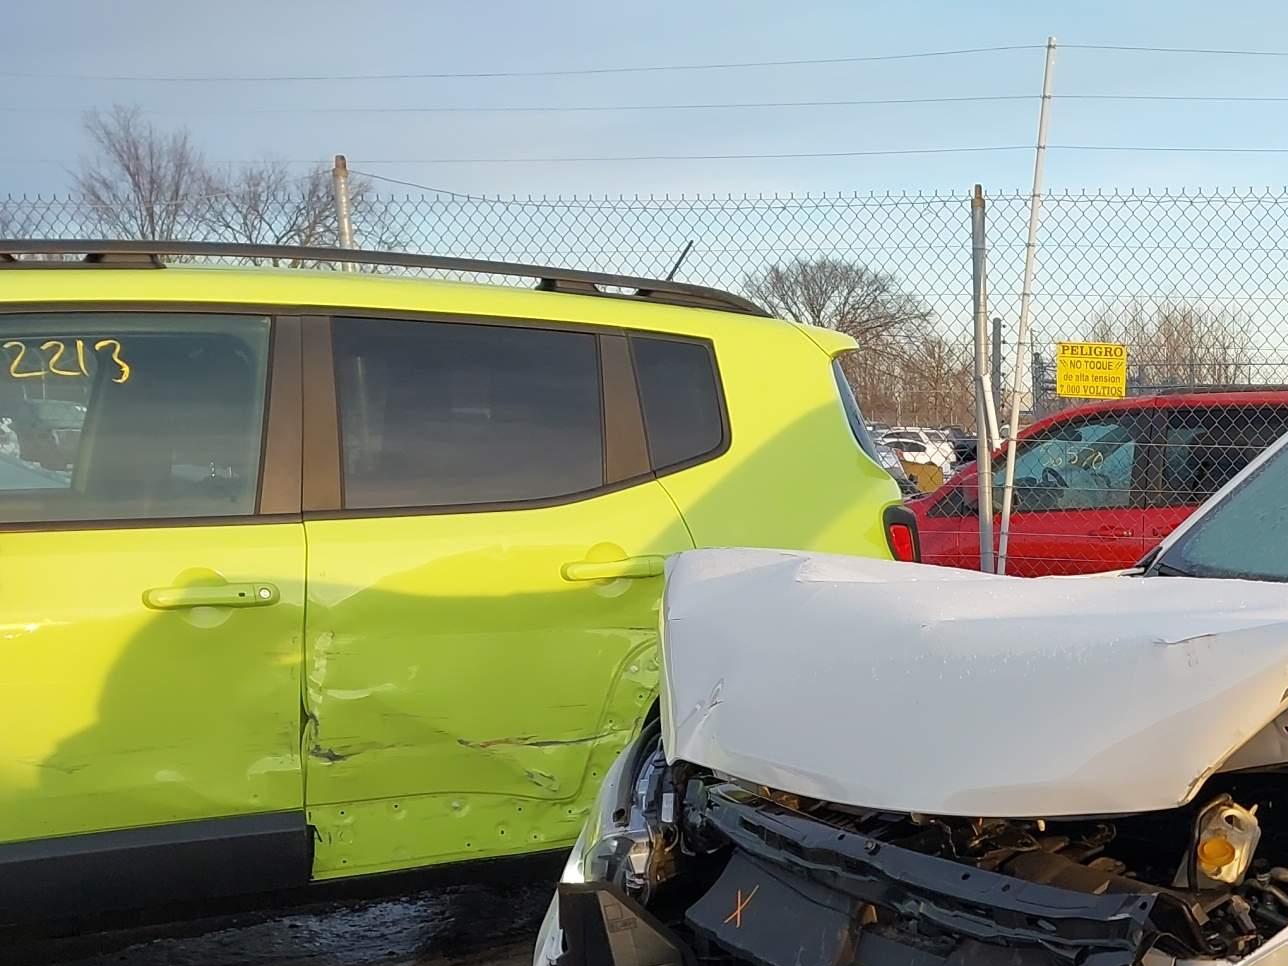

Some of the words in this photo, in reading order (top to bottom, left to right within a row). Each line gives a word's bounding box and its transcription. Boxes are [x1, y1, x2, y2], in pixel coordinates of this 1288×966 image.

[1061, 345, 1124, 358] PELIGRO
[2, 339, 130, 383] 2213
[1069, 360, 1082, 370] NO
[1084, 361, 1113, 370] TOQUE
[1063, 372, 1073, 382] de
[1091, 373, 1121, 384] tension
[1083, 385, 1123, 397] VOLTIOS
